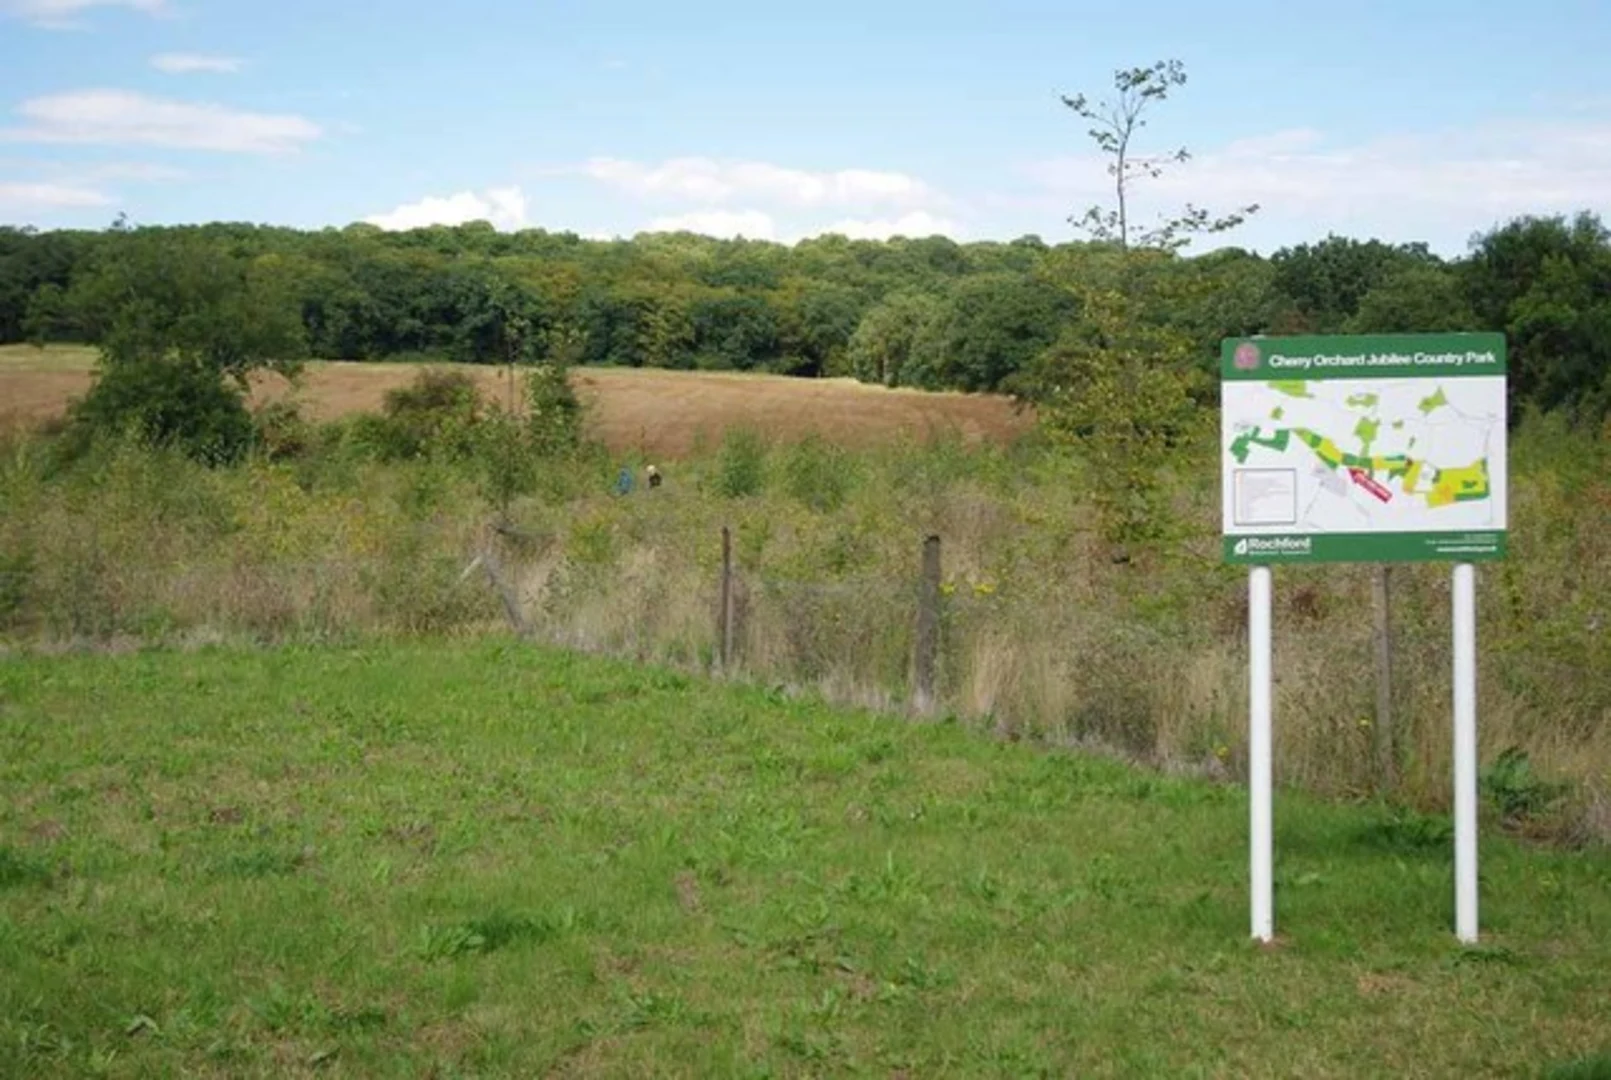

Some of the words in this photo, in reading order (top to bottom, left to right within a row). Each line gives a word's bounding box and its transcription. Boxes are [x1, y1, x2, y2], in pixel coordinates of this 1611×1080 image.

[1269, 354, 1310, 369] Cherry
[1314, 352, 1364, 366] Orchard
[1367, 351, 1411, 365] Jubilee
[1414, 350, 1463, 366] Country
[1466, 349, 1495, 363] Park
[1249, 537, 1311, 549] Rochford
